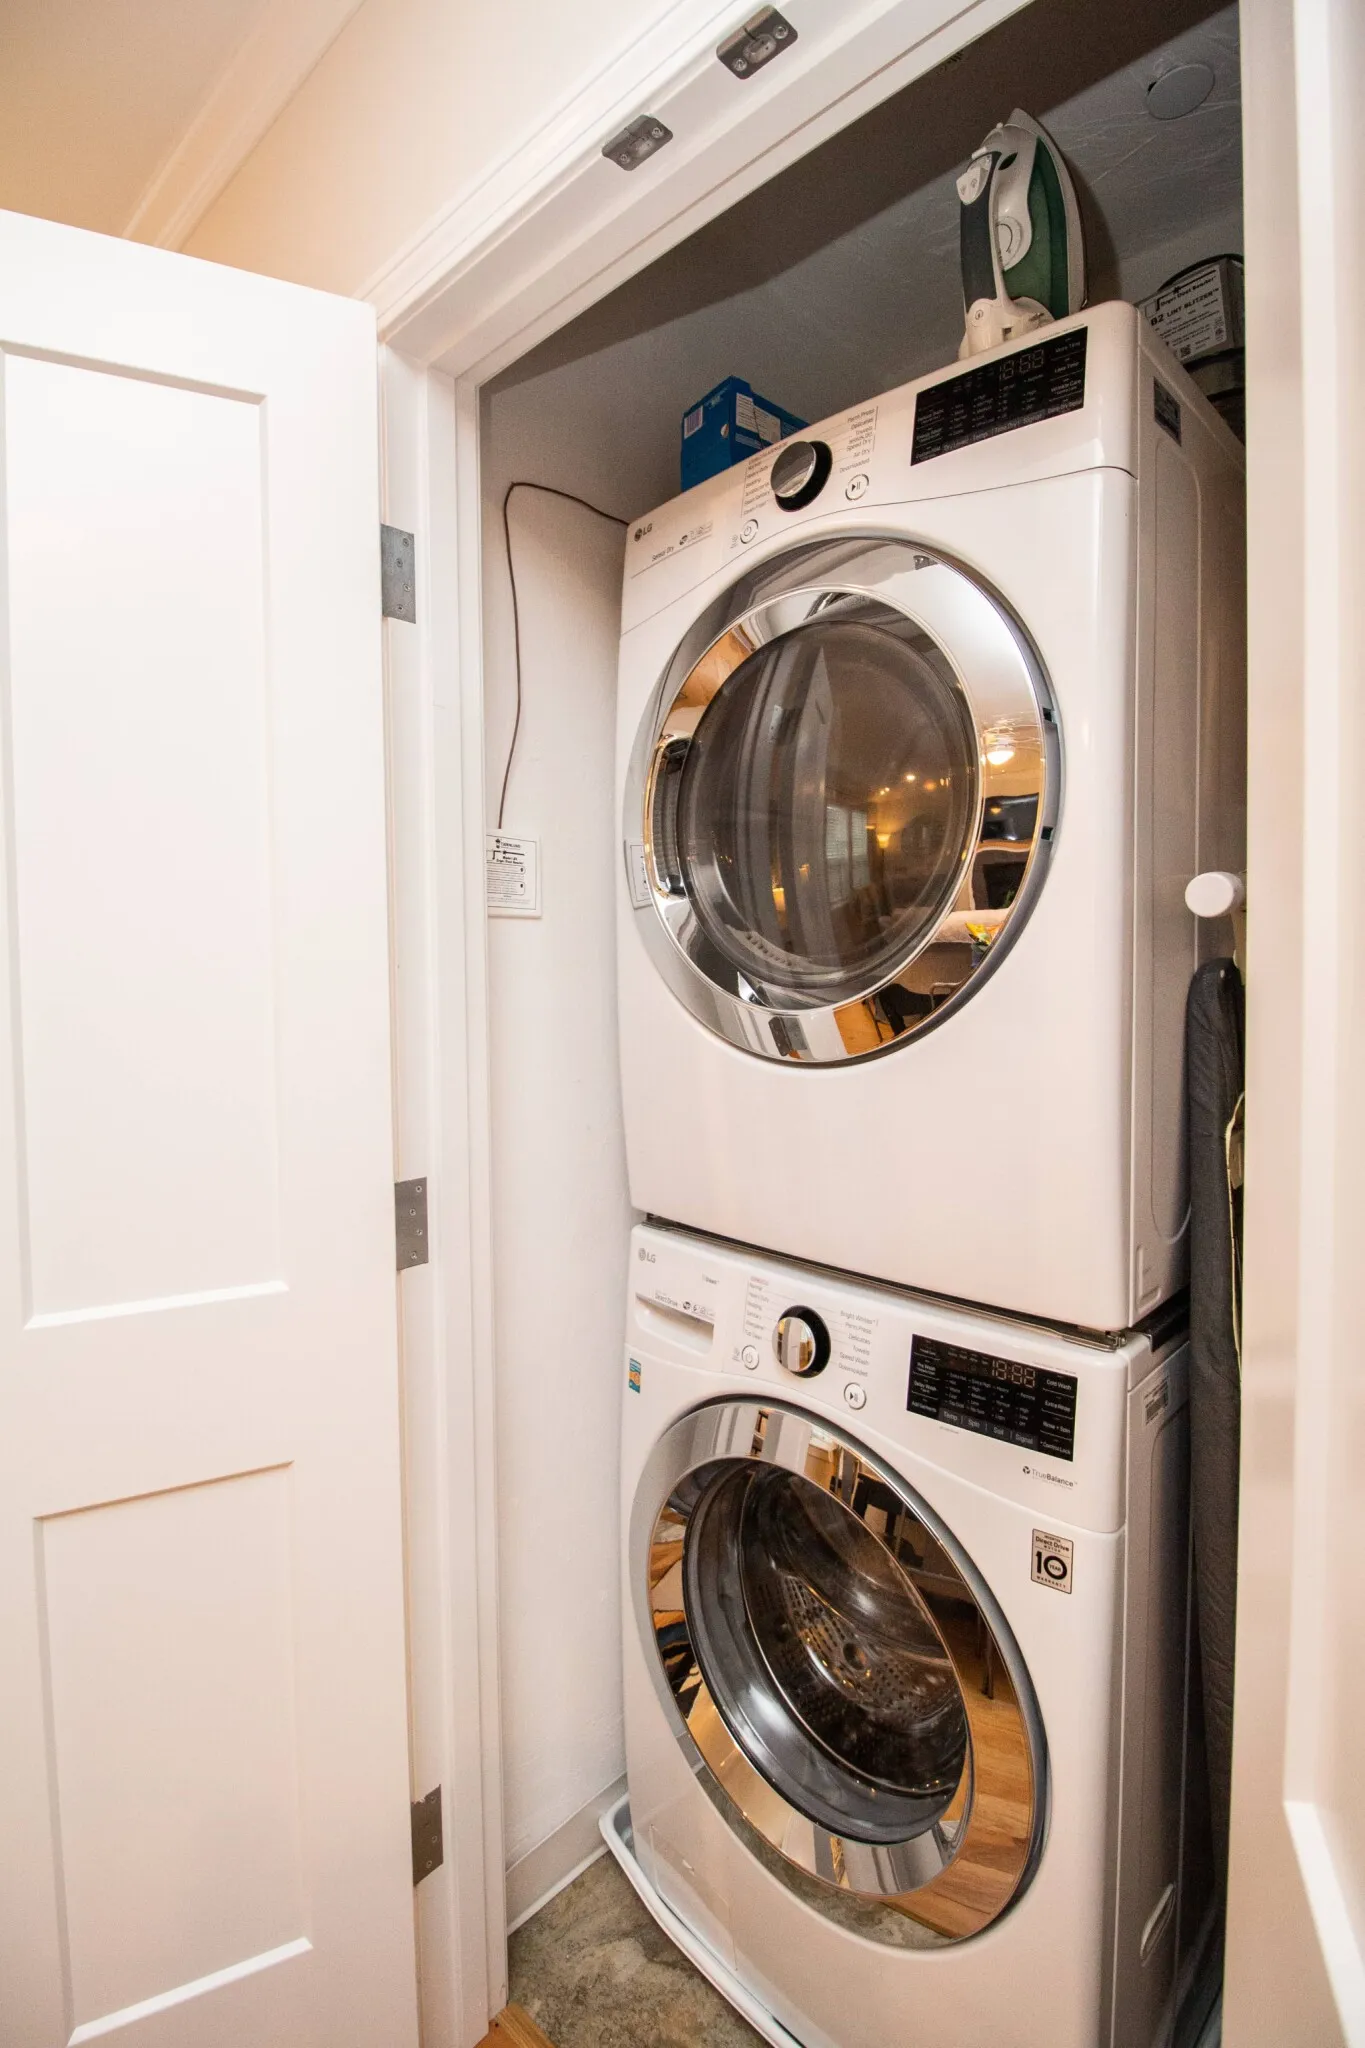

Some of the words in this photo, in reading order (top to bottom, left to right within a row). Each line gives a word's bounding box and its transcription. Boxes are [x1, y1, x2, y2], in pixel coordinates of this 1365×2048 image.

[1035, 1536, 1053, 1547] Direct
[1053, 1542, 1070, 1552] Drive
[1035, 1550, 1068, 1580] 10
